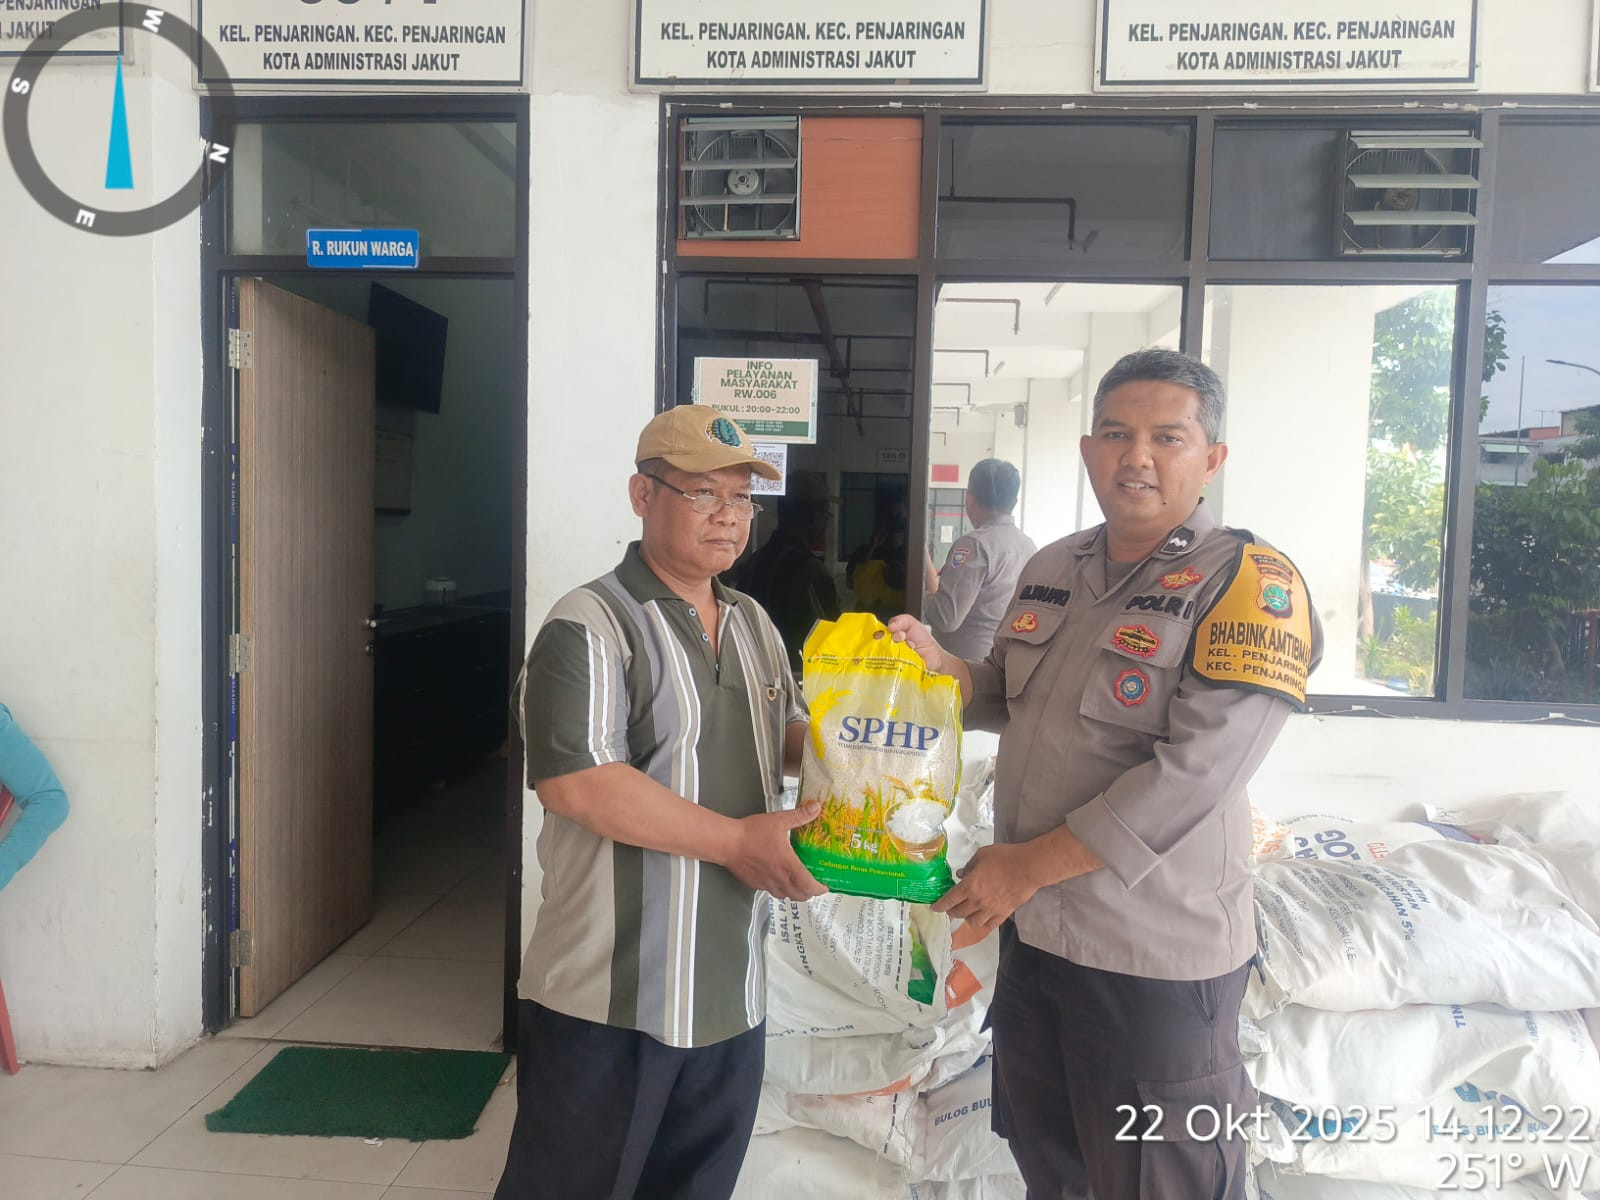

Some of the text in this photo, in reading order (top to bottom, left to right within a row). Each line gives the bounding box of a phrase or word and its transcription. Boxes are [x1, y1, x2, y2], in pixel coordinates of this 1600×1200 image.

[0, 0, 101, 11] ENJARINGAN
[6, 21, 57, 40] JAKUT
[219, 24, 506, 44] KEL. PENJARINGAN. KEC. PENJARINGAN
[660, 20, 966, 42] KEL. PENJARINGAN. KEC. PENJARINGAN
[1128, 19, 1456, 43] KEL. PENJARINGAN. KEC. PENJARINGAN
[263, 52, 460, 71] KOTA ADMINISTRASI JAKUT
[707, 50, 917, 70] KOTA ADMINISTRASI JAKUT
[1176, 49, 1403, 71] KOTA ADMINISTRASI JAKUT
[312, 240, 414, 257] R. RUKUN WARGA
[726, 369, 792, 380] PELAYANAN
[746, 360, 773, 370] INFO
[720, 378, 798, 390] MASYARAKAT
[734, 389, 777, 399] RW.006
[1125, 595, 1195, 620] POLRI
[838, 715, 939, 751] SPHP
[851, 833, 862, 849] 5
[779, 916, 791, 943] ASAL
[1401, 920, 1416, 940] 5%
[935, 1106, 969, 1127] BULOG
